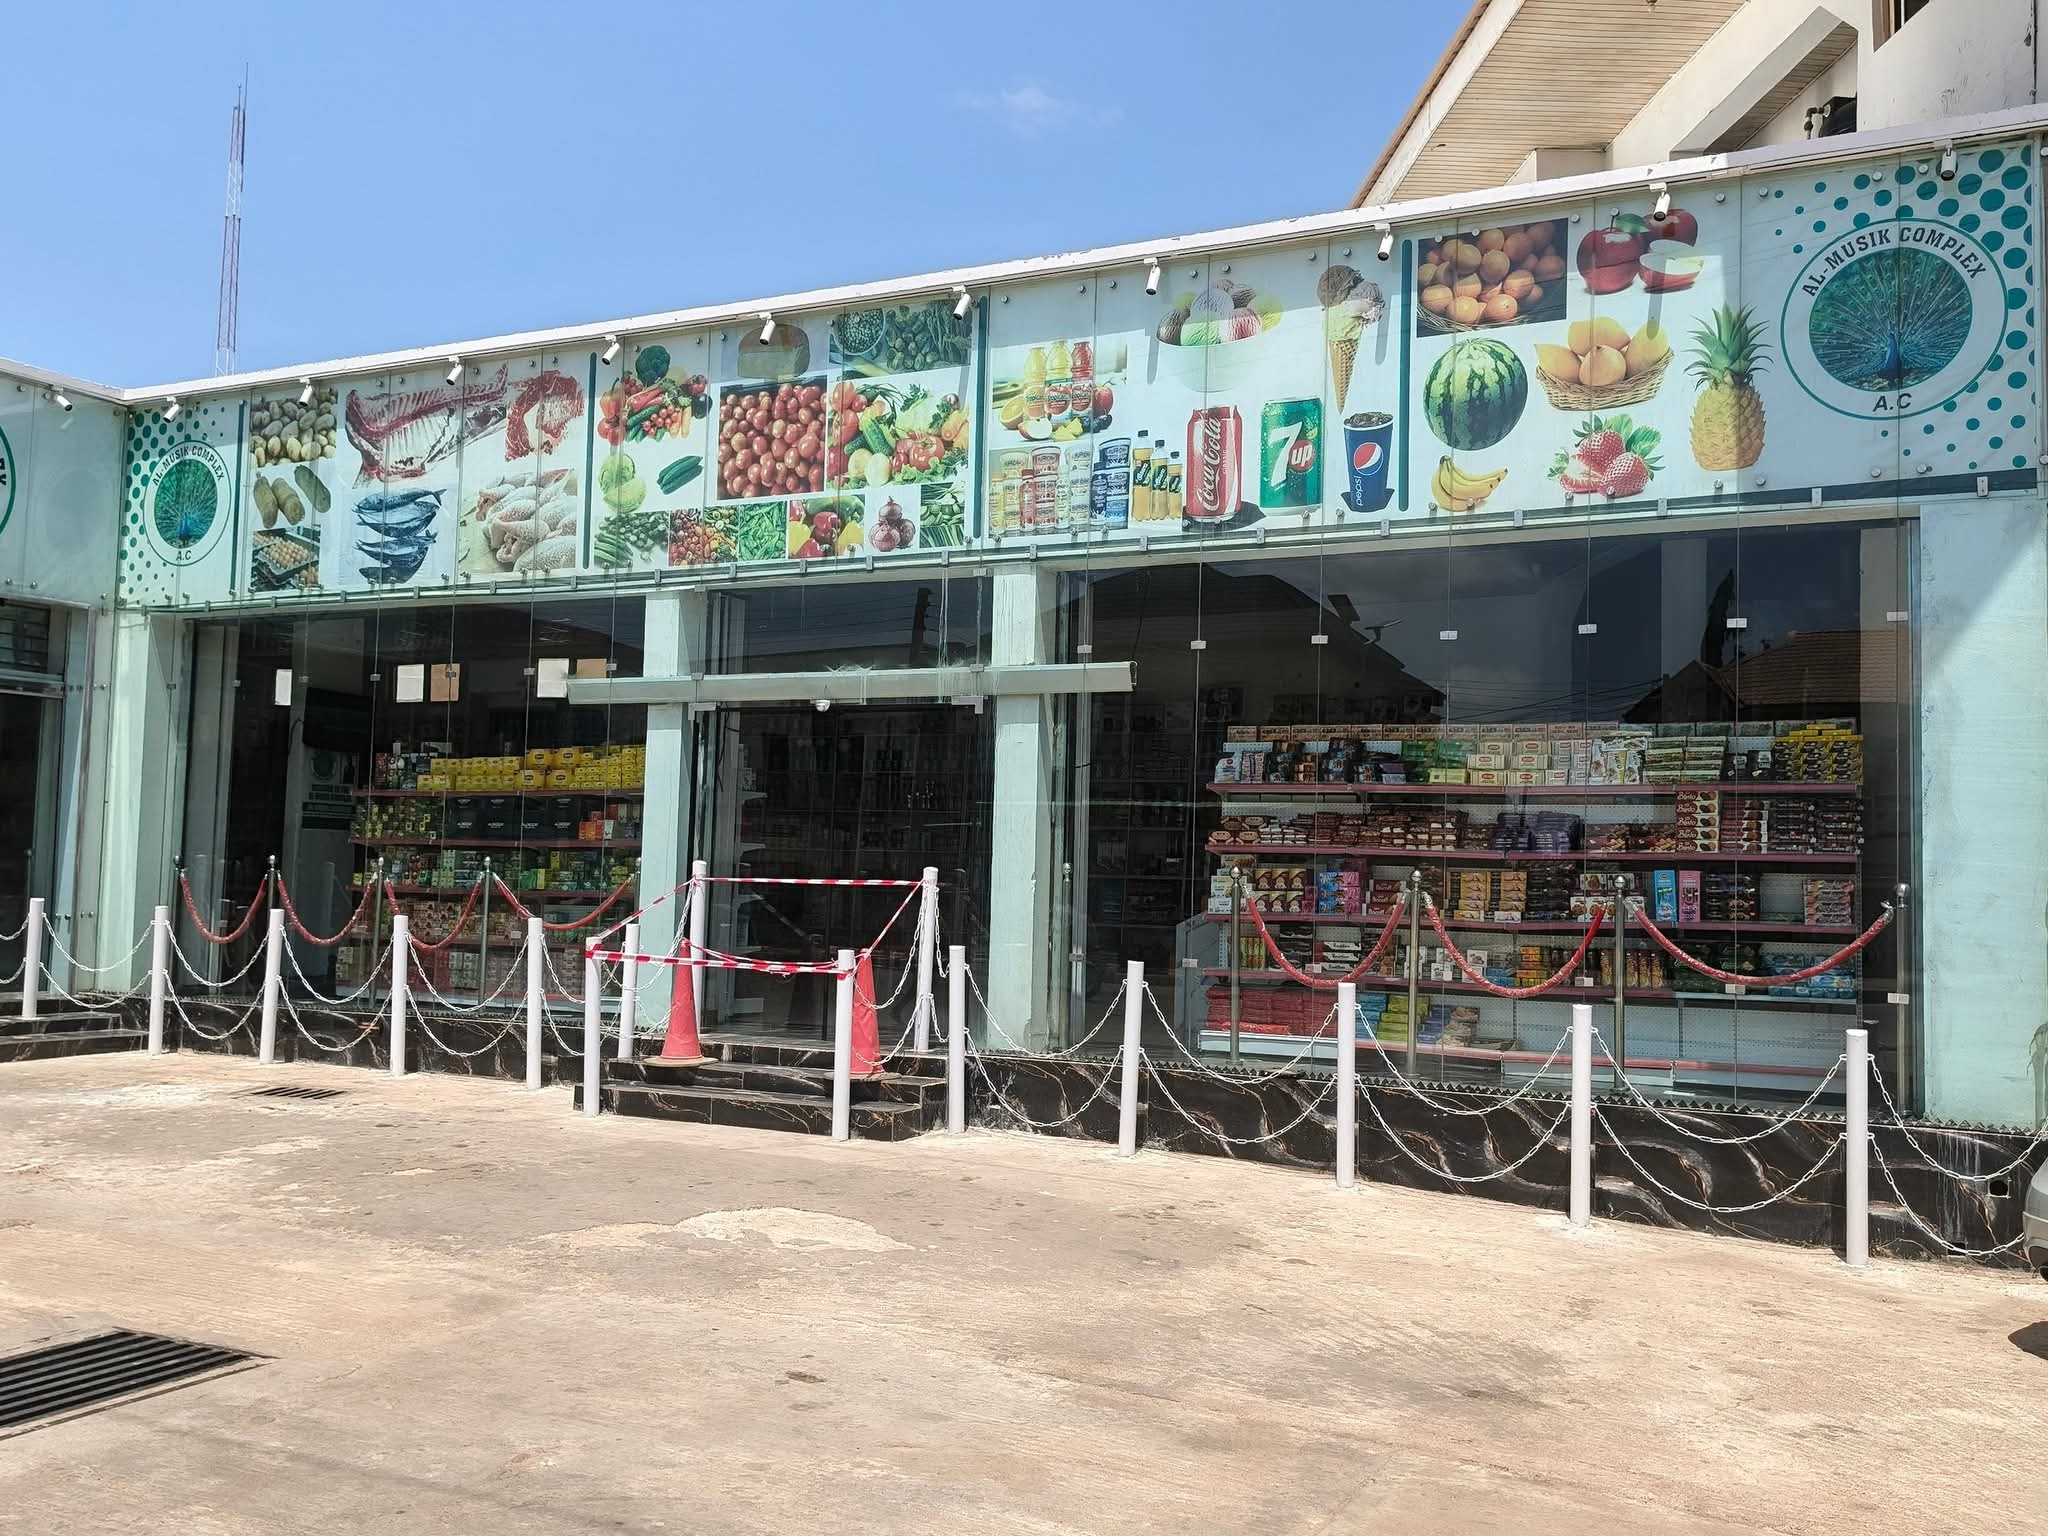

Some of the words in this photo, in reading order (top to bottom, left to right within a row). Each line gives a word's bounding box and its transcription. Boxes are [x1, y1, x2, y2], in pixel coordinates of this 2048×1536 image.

[1801, 228, 1891, 297] AL-MUSIK
[1900, 226, 1987, 280] COMPLEX
[1873, 392, 1912, 412] A.C
[153, 446, 189, 486] AL-MUSIK
[191, 445, 225, 481] COMPLEX
[1354, 475, 1364, 507] pepsi
[176, 550, 192, 561] A.C
